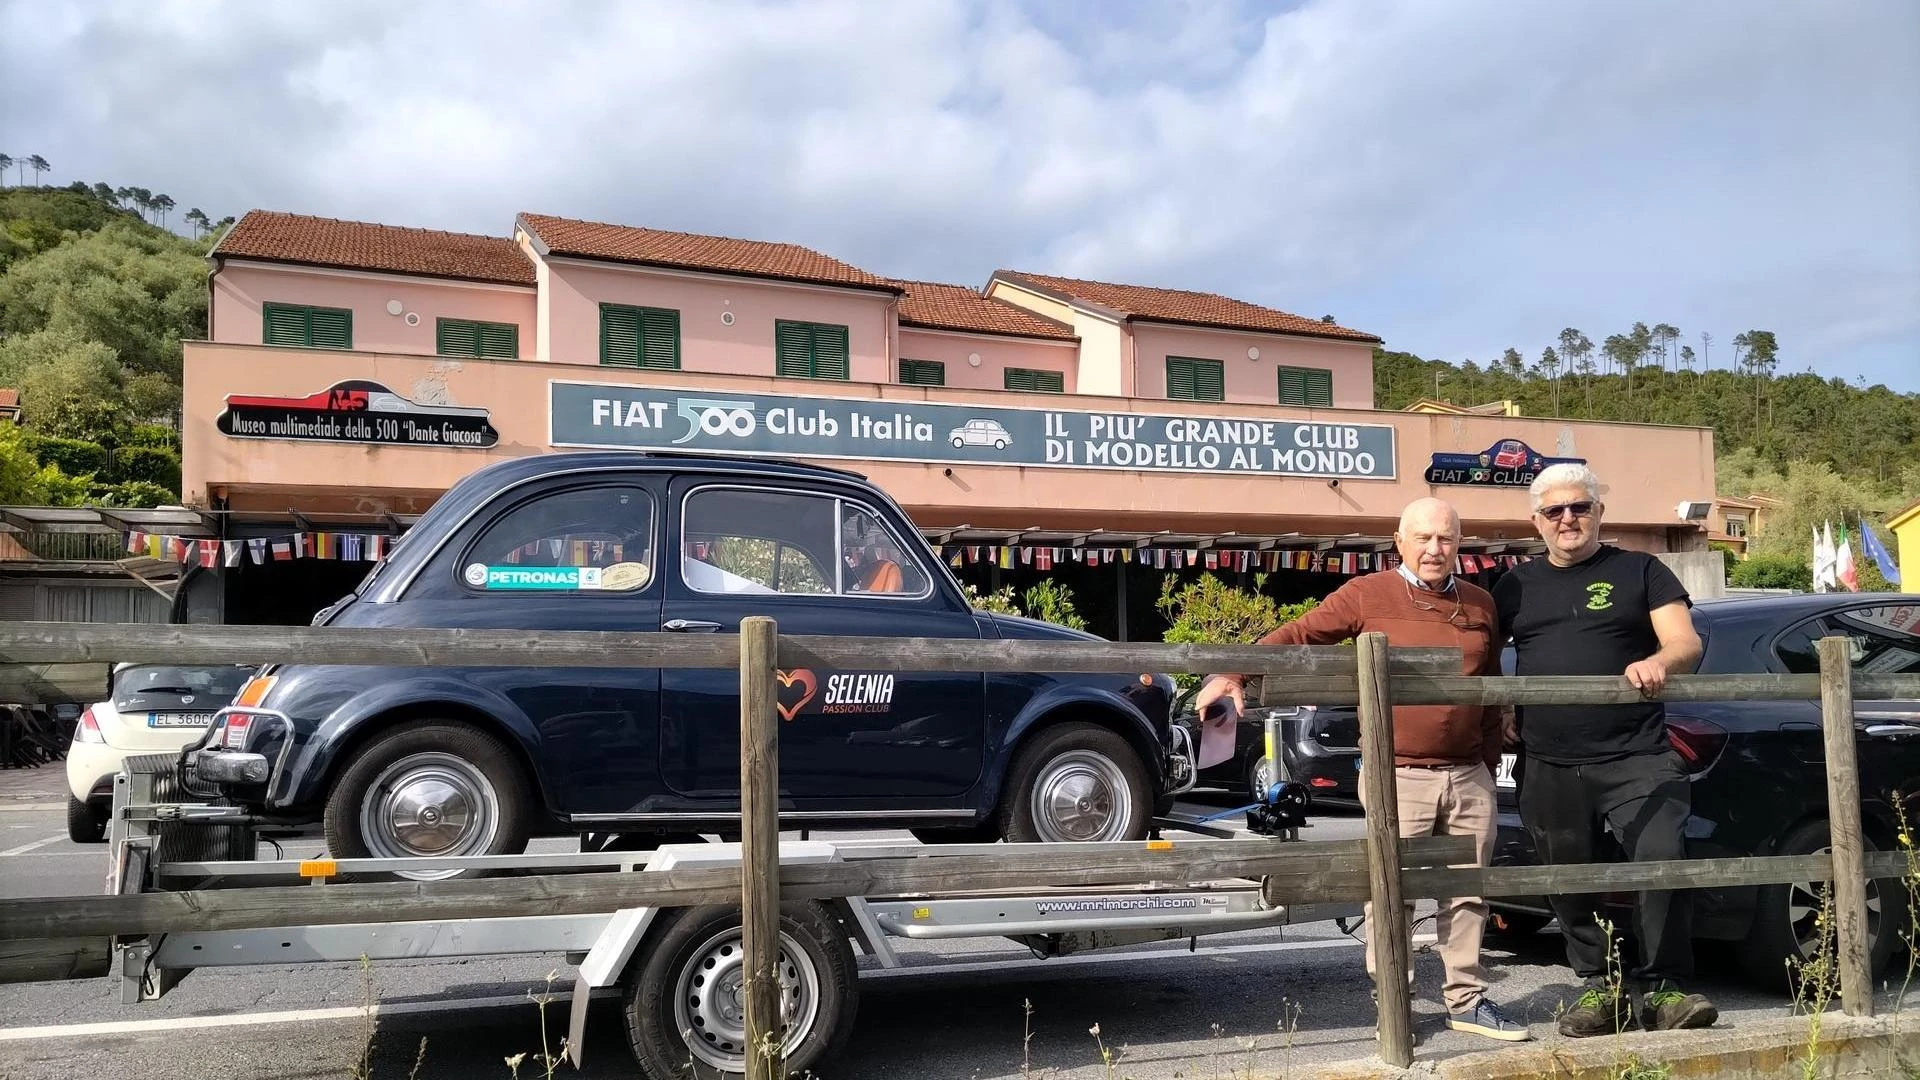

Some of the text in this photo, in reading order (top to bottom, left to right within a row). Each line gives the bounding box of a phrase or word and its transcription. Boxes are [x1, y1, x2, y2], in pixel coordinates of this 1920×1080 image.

[232, 411, 266, 434] Museo
[270, 416, 341, 438] multimediale
[345, 424, 371, 439] della
[376, 421, 398, 440] 500
[592, 398, 933, 443] FIAT 500 Club Italia
[1045, 413, 1068, 437] IL
[1165, 419, 1275, 446] GRANDE
[1294, 425, 1359, 450] CLUB
[1045, 439, 1375, 475] DI MODELLO AL MONDO
[1431, 468, 1534, 485] FIAT 500 CLUB
[489, 571, 578, 584] PETRONAS
[825, 674, 894, 704] SELENIA
[157, 714, 172, 724] EL
[822, 704, 889, 713] PASSION CLUB
[1036, 896, 1196, 912] www.mrimarchi.com
